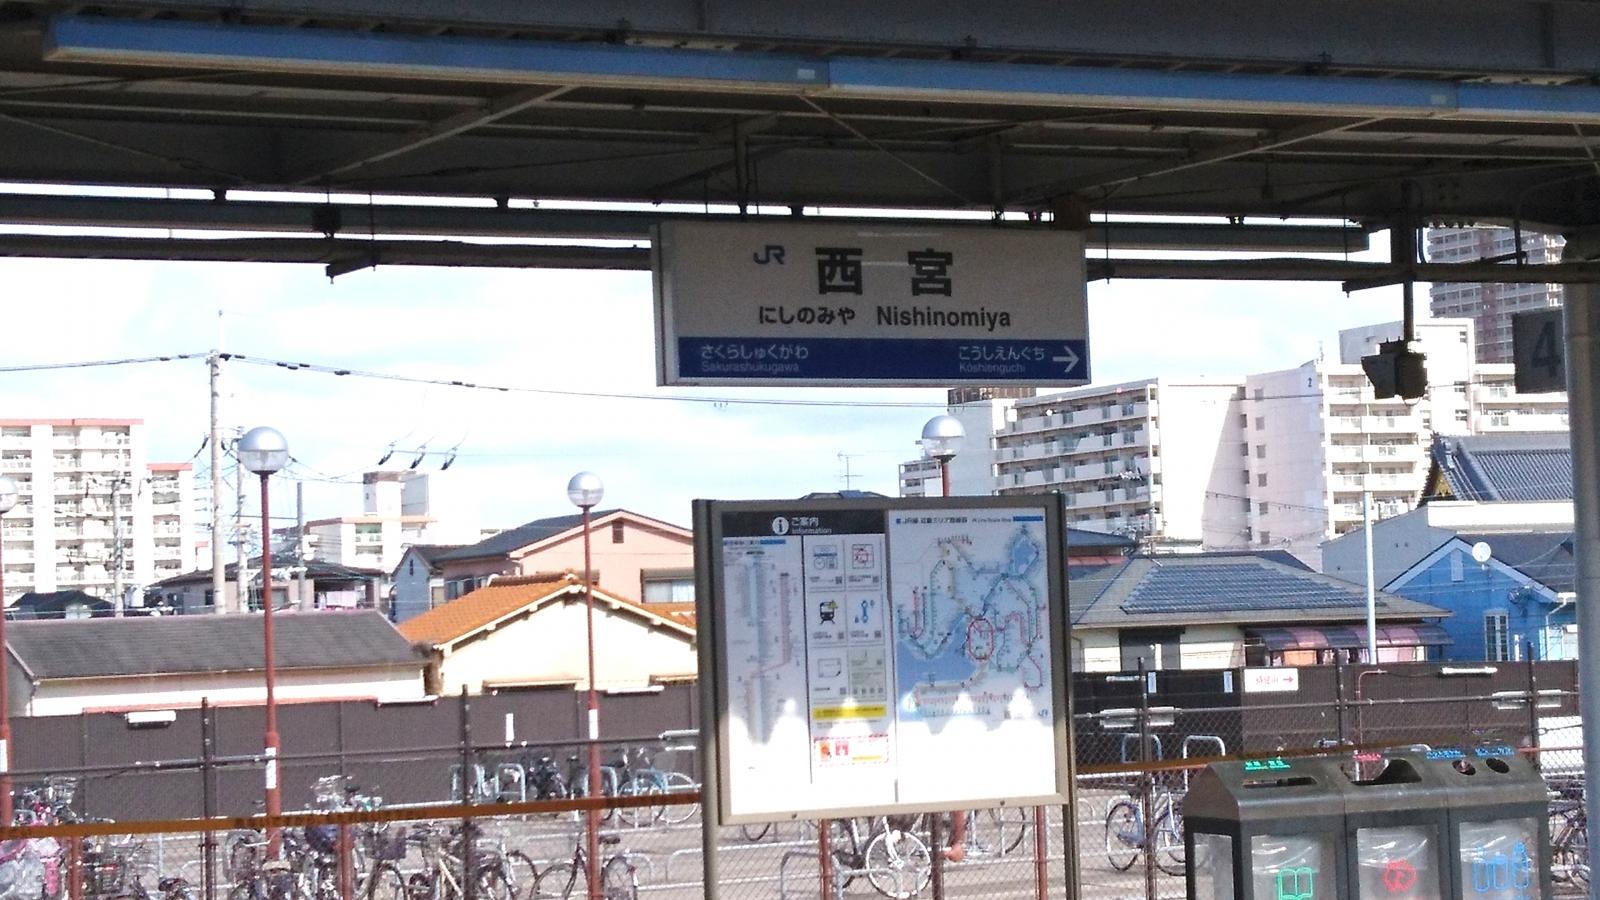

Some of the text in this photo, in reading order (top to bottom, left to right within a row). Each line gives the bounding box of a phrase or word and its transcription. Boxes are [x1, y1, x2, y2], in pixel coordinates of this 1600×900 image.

[753, 245, 785, 265] JR
[759, 306, 855, 325] にしのみや
[877, 306, 1011, 331] Nishinomiya
[701, 344, 809, 360] さくらしゅくがわ
[959, 345, 1045, 361] こうしえんぐち
[1531, 321, 1561, 377] 4
[702, 360, 800, 375] Sakurashukugawa
